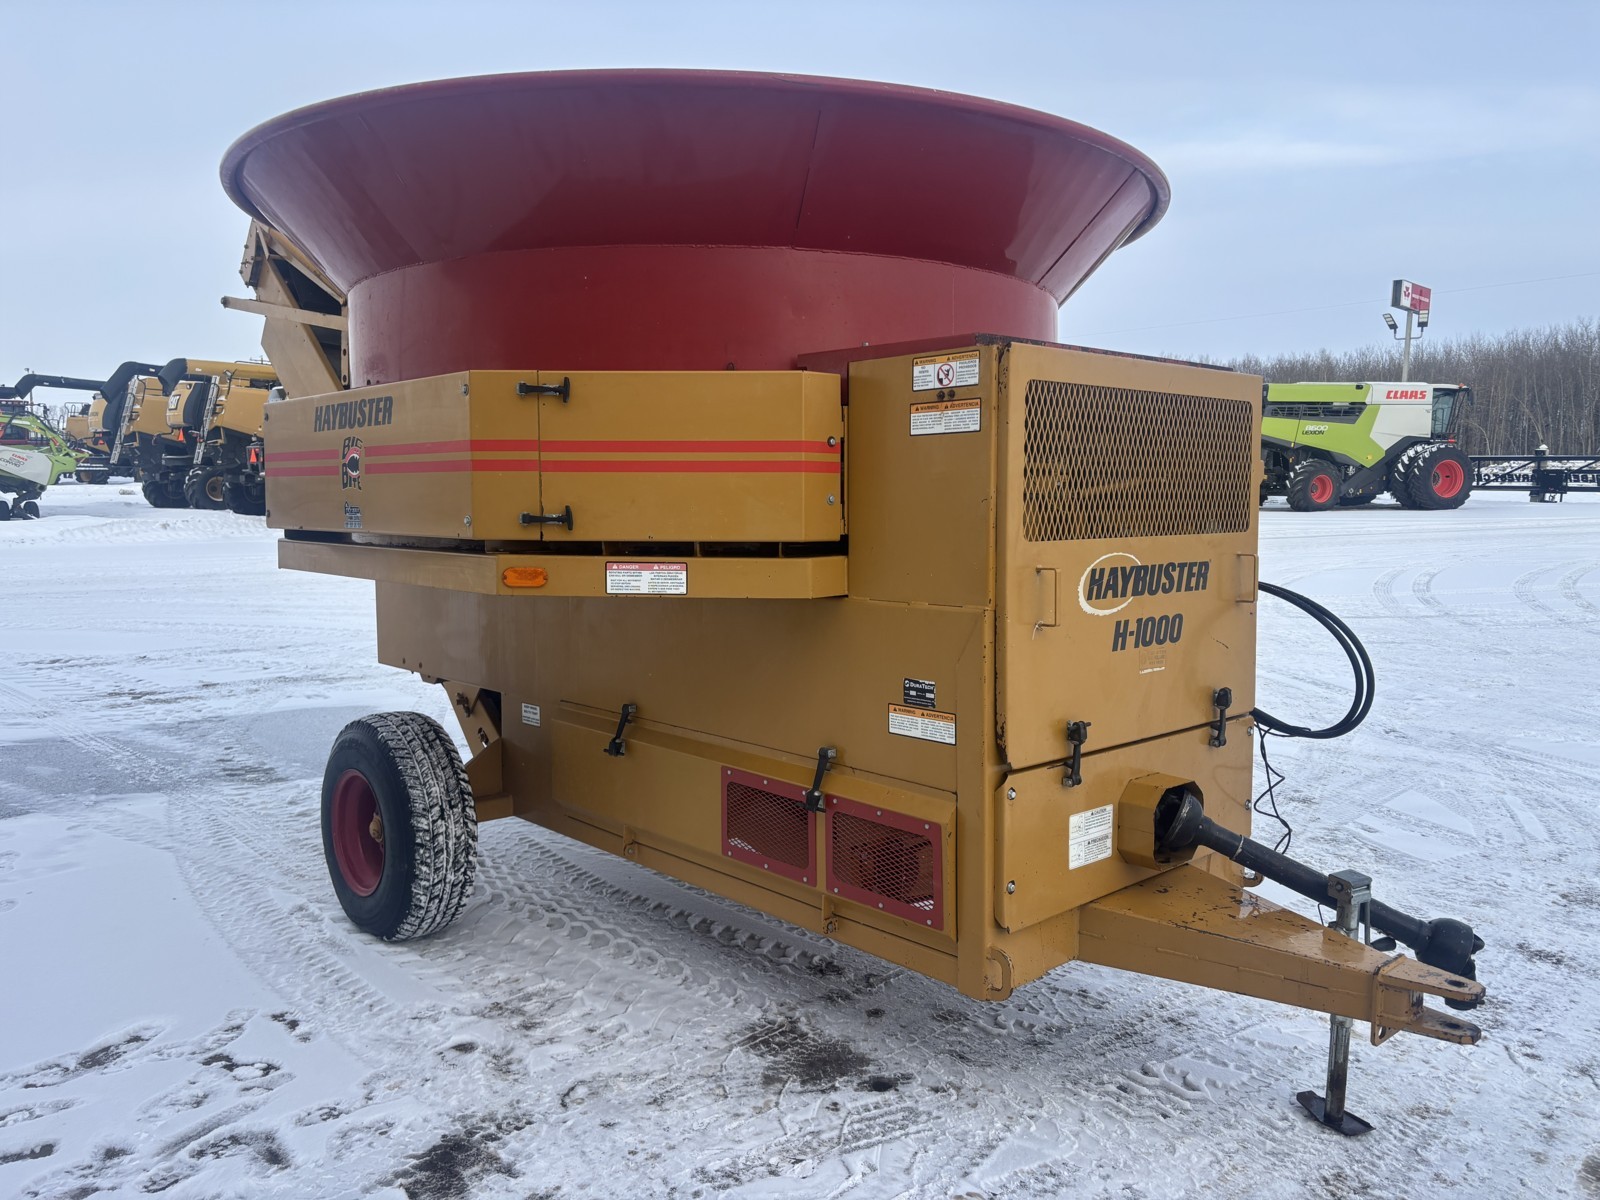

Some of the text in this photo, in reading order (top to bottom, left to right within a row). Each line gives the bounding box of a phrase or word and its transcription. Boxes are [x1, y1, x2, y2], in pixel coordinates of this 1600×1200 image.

[1386, 390, 1427, 400] CLAAS
[314, 396, 393, 432] HAYBUSTER
[342, 462, 362, 490] BITE
[1086, 561, 1209, 600] HAYBUSTER
[1112, 613, 1183, 652] H-1000
